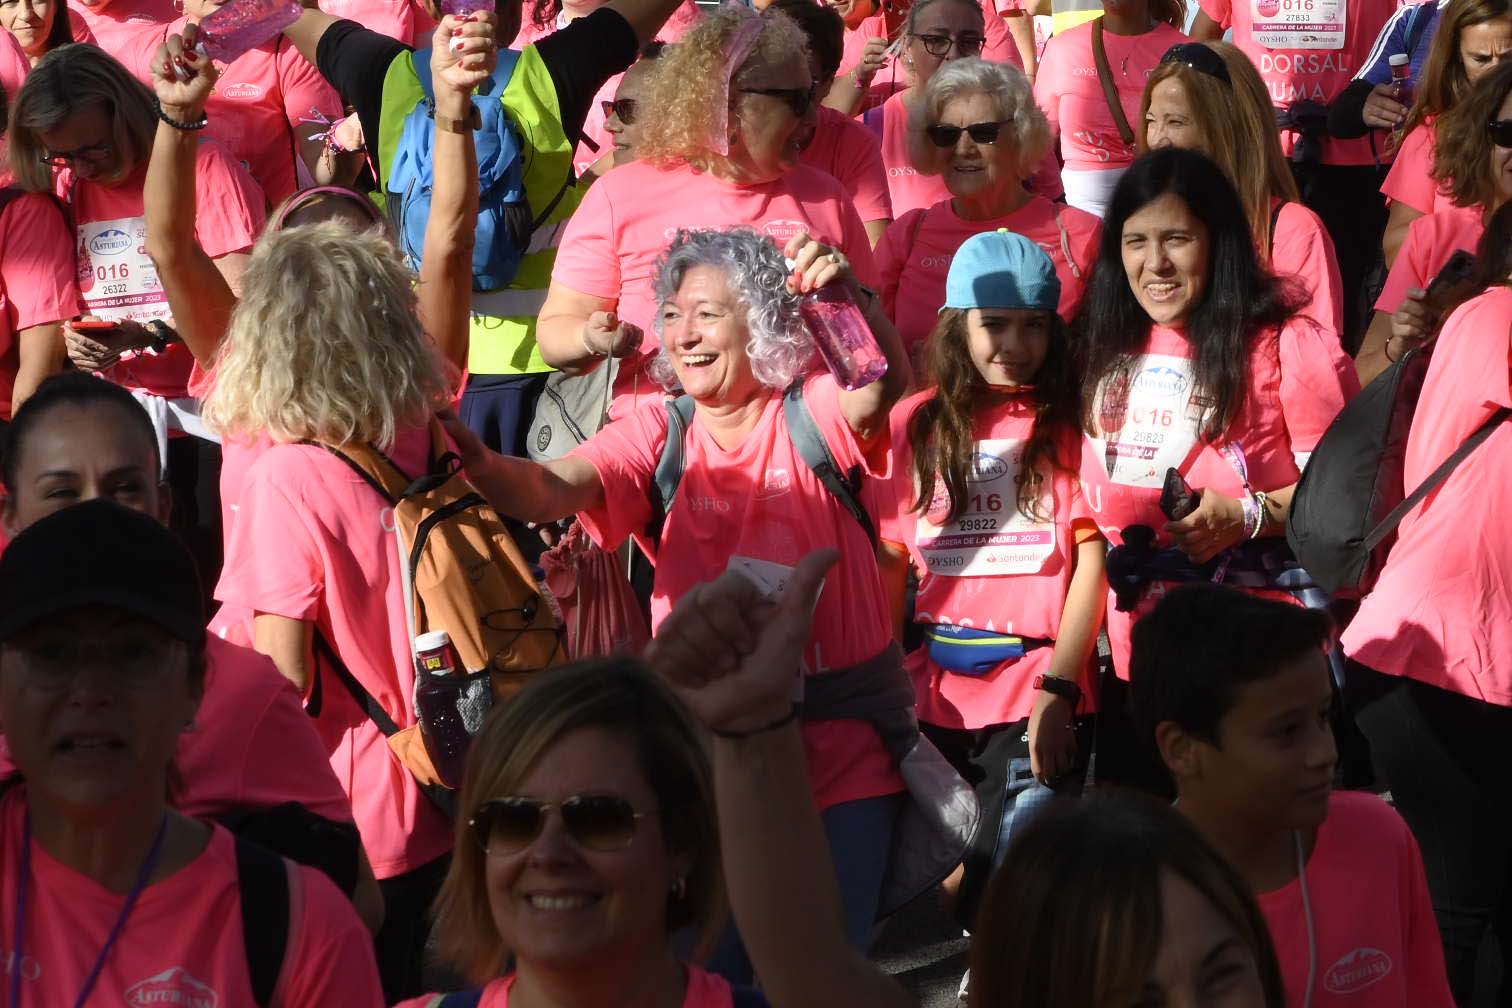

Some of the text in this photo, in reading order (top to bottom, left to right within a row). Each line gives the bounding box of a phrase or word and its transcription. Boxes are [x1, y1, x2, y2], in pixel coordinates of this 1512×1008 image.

[1283, 0, 1314, 10] 016
[1261, 53, 1347, 73] DORSAL
[1266, 80, 1325, 101] UMA
[921, 256, 952, 267] OYS
[97, 263, 129, 281] 016
[103, 283, 127, 295] 26322
[971, 493, 1002, 513] 16
[959, 518, 997, 532] 29822
[988, 535, 1018, 543] MUJER
[927, 556, 964, 567] OYSHO
